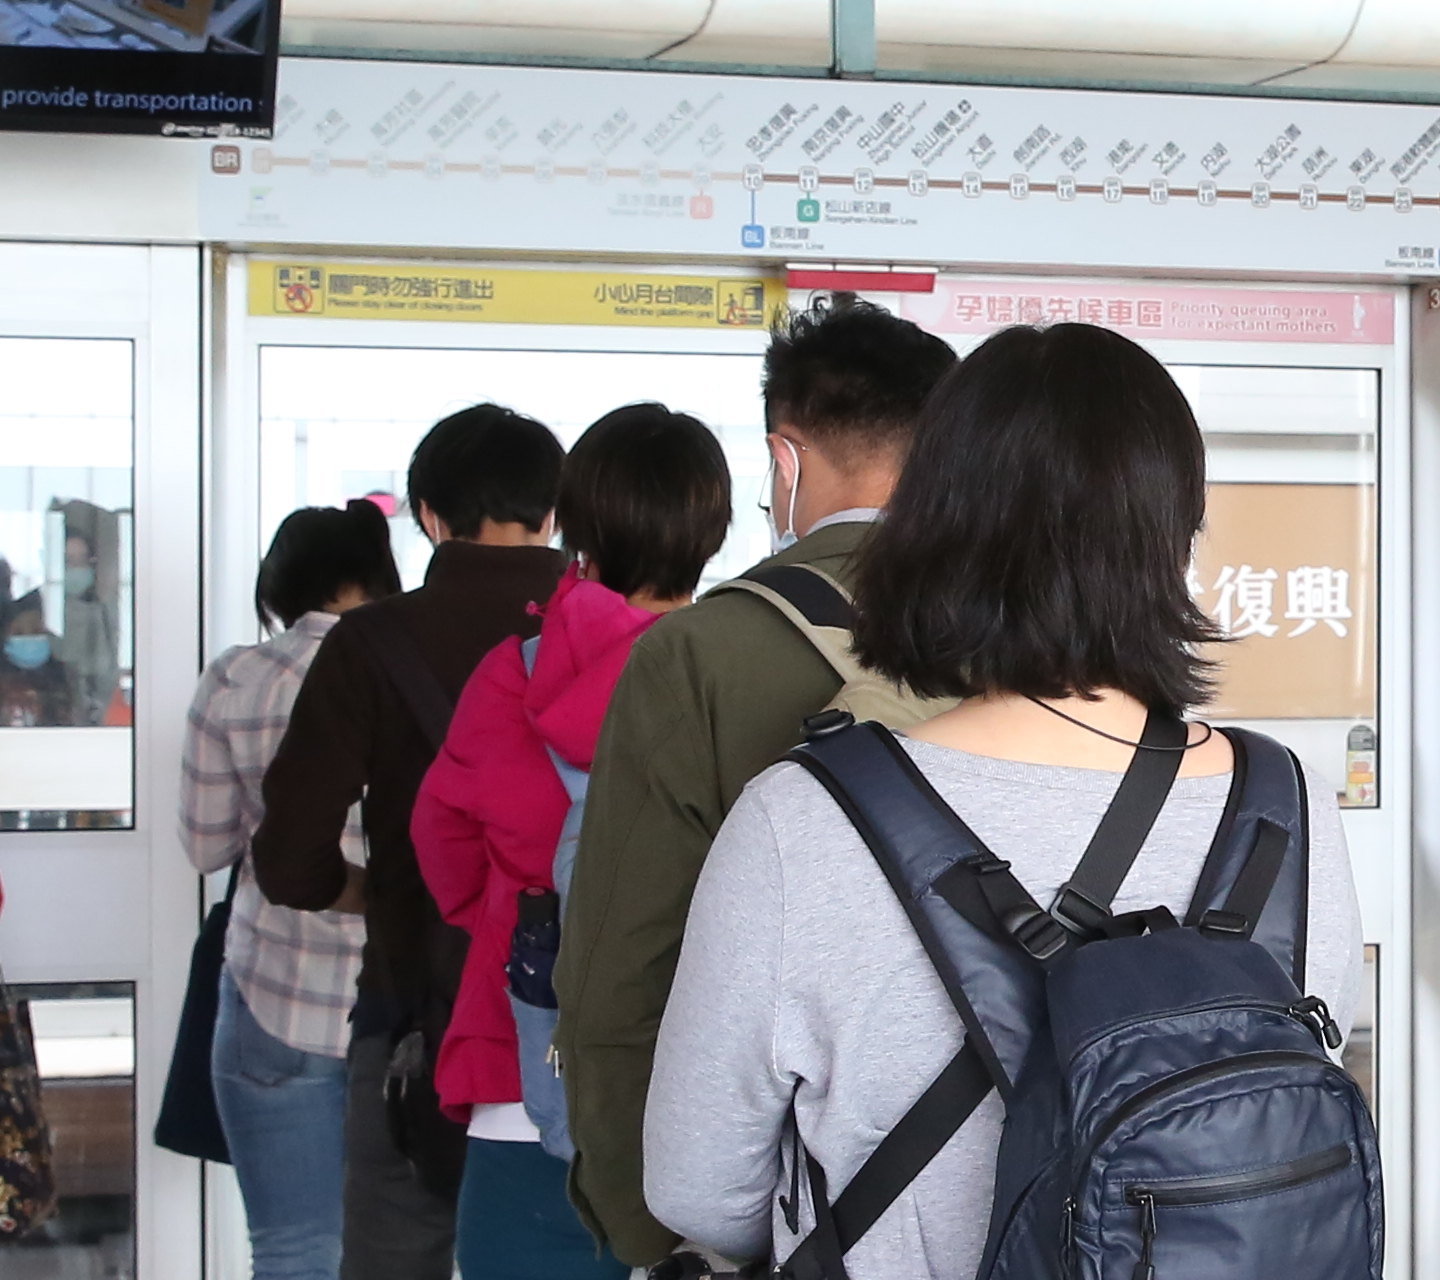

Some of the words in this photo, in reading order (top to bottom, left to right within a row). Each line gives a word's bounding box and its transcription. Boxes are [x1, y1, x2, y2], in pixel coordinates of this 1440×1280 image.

[2, 86, 89, 108] provide
[94, 90, 253, 114] transportation
[213, 150, 239, 168] BR
[801, 178, 815, 188] 11
[858, 180, 871, 191] 12
[911, 182, 925, 193] 13
[965, 184, 979, 195] 14
[1106, 188, 1120, 199] 17
[1302, 196, 1316, 207] 21
[803, 204, 815, 217] G
[745, 231, 761, 243] BL
[328, 273, 495, 300] 關門時勿強行進出
[594, 283, 714, 306] 小心月台間隙
[614, 306, 638, 317] Mind
[639, 306, 654, 317] the
[656, 307, 695, 319] platform
[956, 295, 1163, 328] 孕婦優先候車區
[1170, 301, 1224, 318] Priority
[1230, 304, 1291, 320] queuing
[1296, 307, 1327, 318] area
[1171, 316, 1193, 328] for
[1197, 318, 1270, 333] expectant
[1275, 319, 1337, 334] mothers
[1188, 563, 1353, 639] 復興
